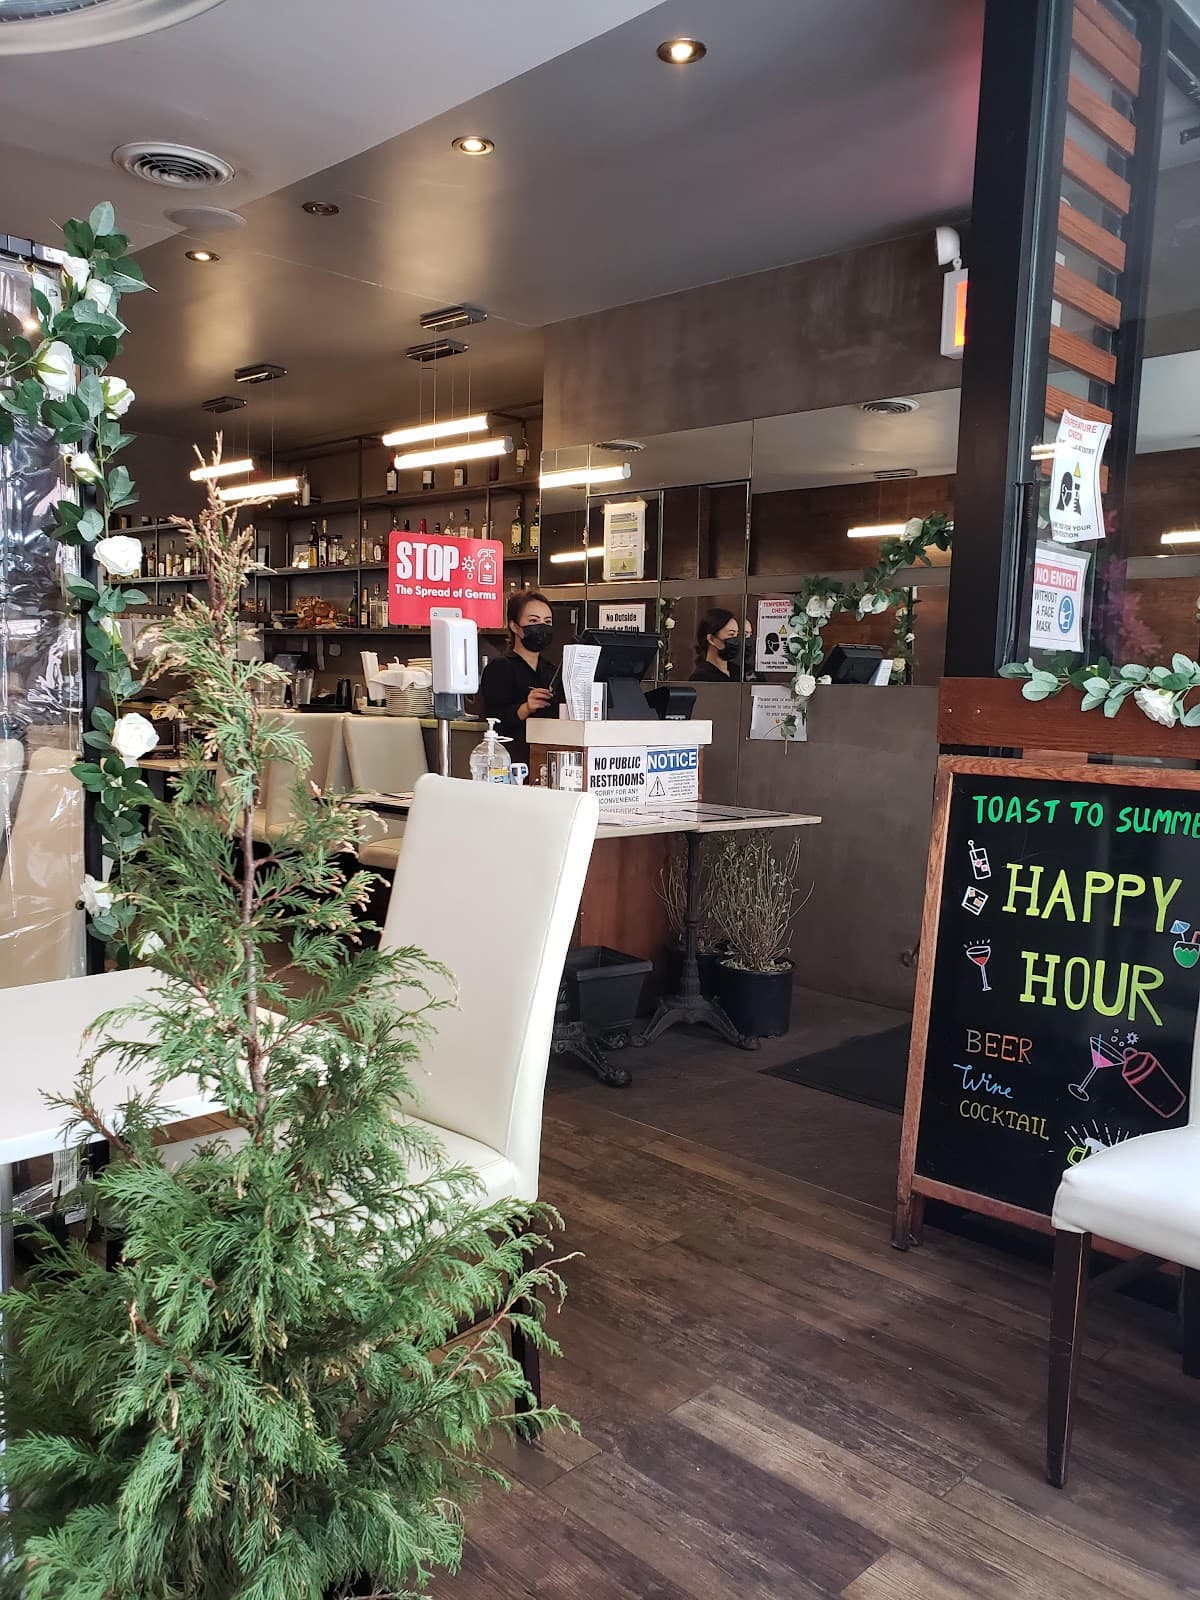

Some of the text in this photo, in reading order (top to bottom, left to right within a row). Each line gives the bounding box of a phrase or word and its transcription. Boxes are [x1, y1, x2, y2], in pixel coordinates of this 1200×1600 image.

[396, 541, 460, 582] STOP
[1034, 567, 1077, 589] NO ENTRY
[395, 584, 497, 600] The Spread of Germs
[1034, 588, 1058, 604] WITHOUT
[606, 612, 637, 622] No Outside
[1035, 604, 1055, 618] A FACE
[1035, 619, 1051, 632] MASK
[594, 756, 641, 770] NO PUBLIC
[647, 751, 697, 769] NOTICE
[590, 772, 645, 788] RESTROOMS
[594, 788, 614, 797] SORRY
[627, 787, 639, 795] ANY
[599, 796, 640, 804] CONVENIENCE
[972, 795, 1061, 824] TOAST
[1069, 801, 1104, 827] TO
[1001, 862, 1183, 933] HAPPY
[1019, 950, 1165, 1026] HOUR
[965, 1028, 1033, 1065] BEER
[953, 1064, 1014, 1099] Wine
[960, 1100, 1050, 1141] COCKTAIL
